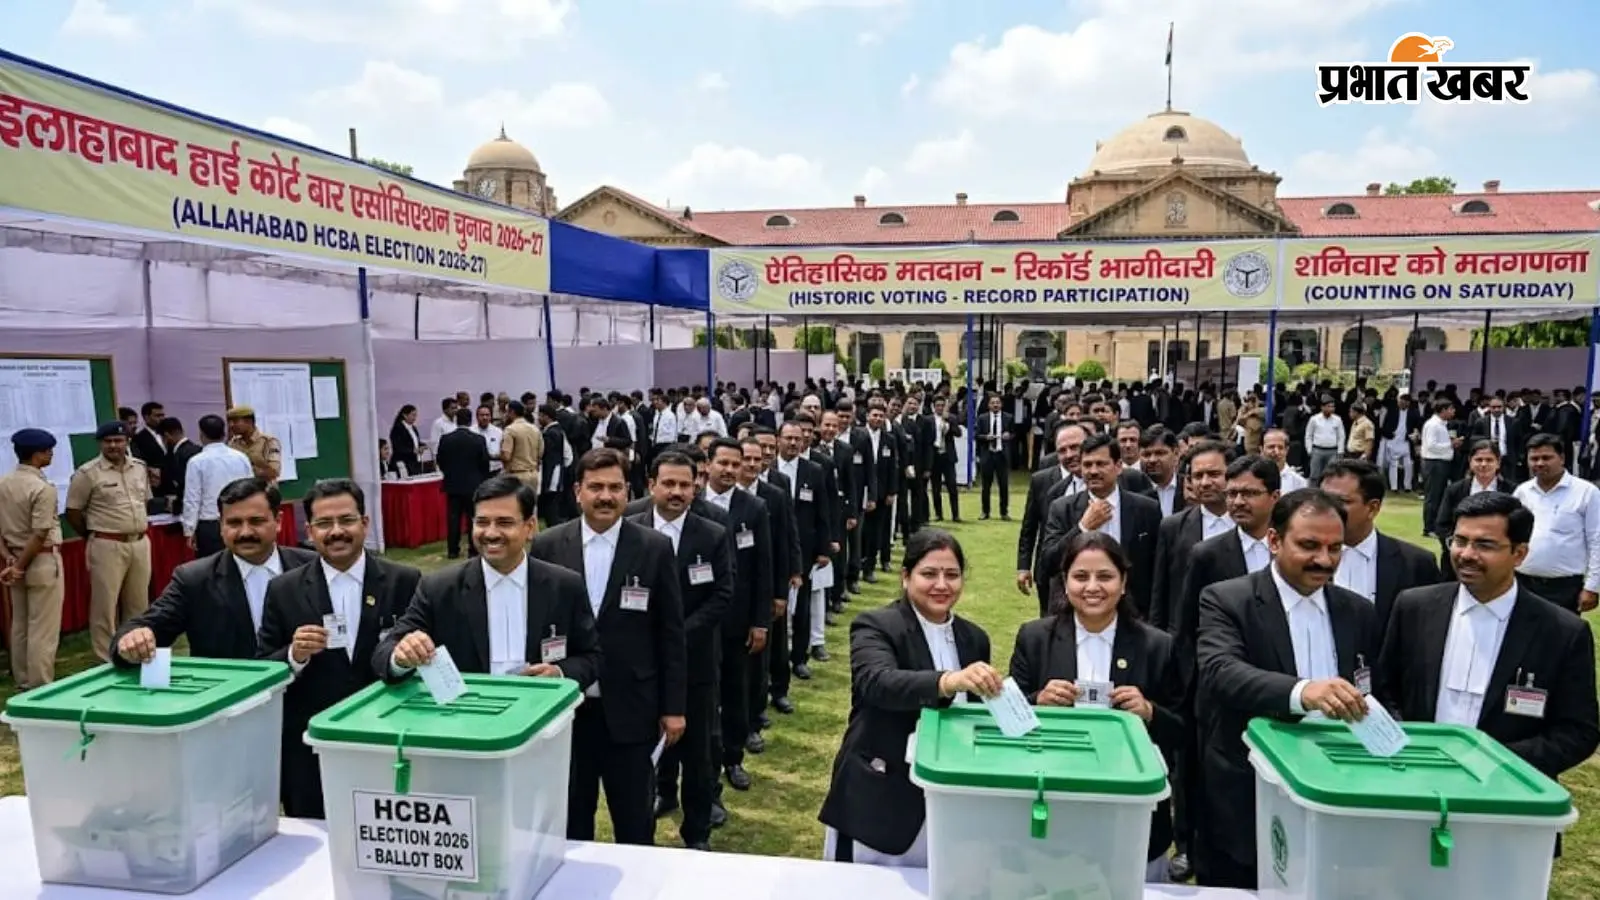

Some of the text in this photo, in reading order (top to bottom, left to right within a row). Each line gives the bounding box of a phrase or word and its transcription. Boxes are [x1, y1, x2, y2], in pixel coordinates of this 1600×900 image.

[0, 92, 178, 176] इलाहाबाद
[187, 140, 240, 195] हाई
[248, 152, 301, 203] कोर्ट
[306, 174, 345, 212] बार
[349, 181, 450, 235] एसोसिएशन
[454, 212, 493, 250] चुनाव
[173, 196, 487, 279] (ALLAHABAD HCBA ELECTION 2026-27)
[765, 254, 889, 285] ऐतिहासिक
[896, 261, 983, 282] मतदान
[1014, 250, 1093, 281] रिकॉर्ड
[1100, 248, 1216, 280] भागीदारी
[1295, 246, 1400, 277] शनिवार
[1406, 246, 1446, 276] को
[1454, 250, 1590, 275] मतगणना
[788, 290, 875, 308] (HISTORIC
[881, 290, 947, 305] VOTING
[964, 288, 1037, 304] RECORD
[1043, 287, 1189, 305] PARTICIPATION)
[1304, 282, 1574, 303] (COUNTING ON SATURDAY)
[374, 798, 451, 825] HCBA
[359, 825, 469, 849] ELECTION 2026
[375, 848, 430, 867] BALLOT
[434, 852, 463, 870] BOX
